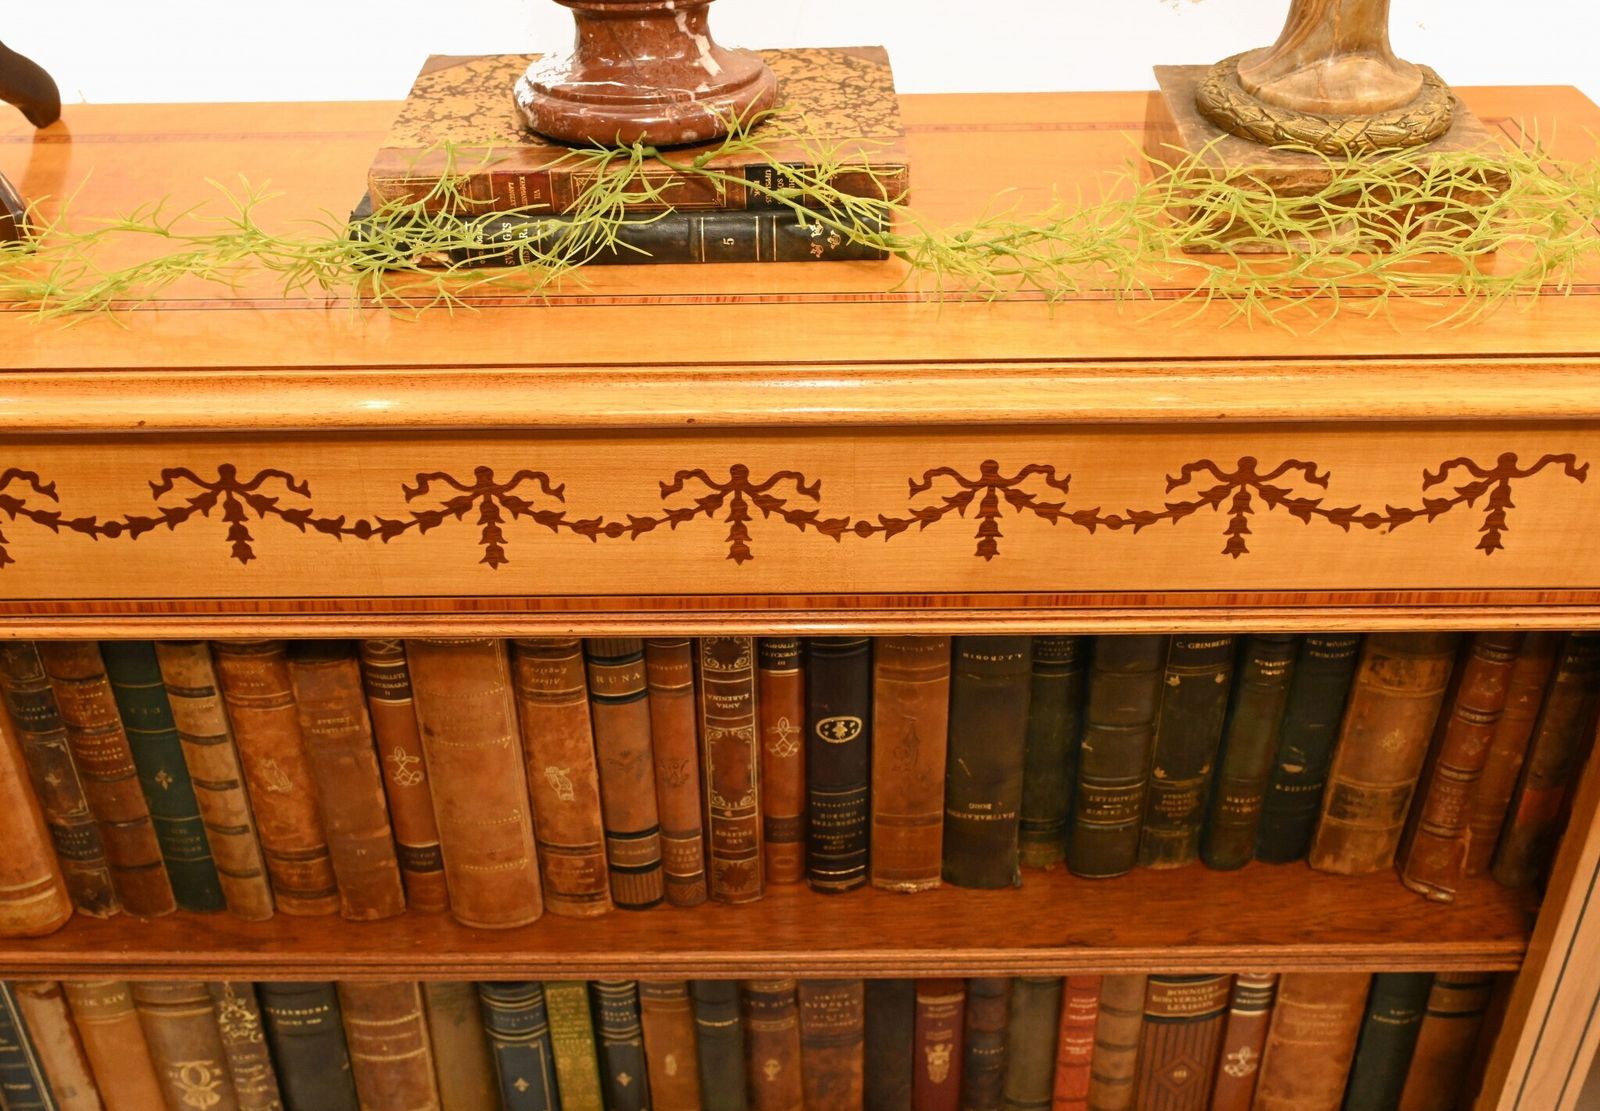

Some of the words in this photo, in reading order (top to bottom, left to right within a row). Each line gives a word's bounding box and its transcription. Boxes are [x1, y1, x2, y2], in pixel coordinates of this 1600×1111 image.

[723, 237, 735, 247] 5
[1187, 638, 1232, 651] GRIMBERG
[596, 671, 642, 684] RUNA
[706, 692, 750, 702] KARENINA
